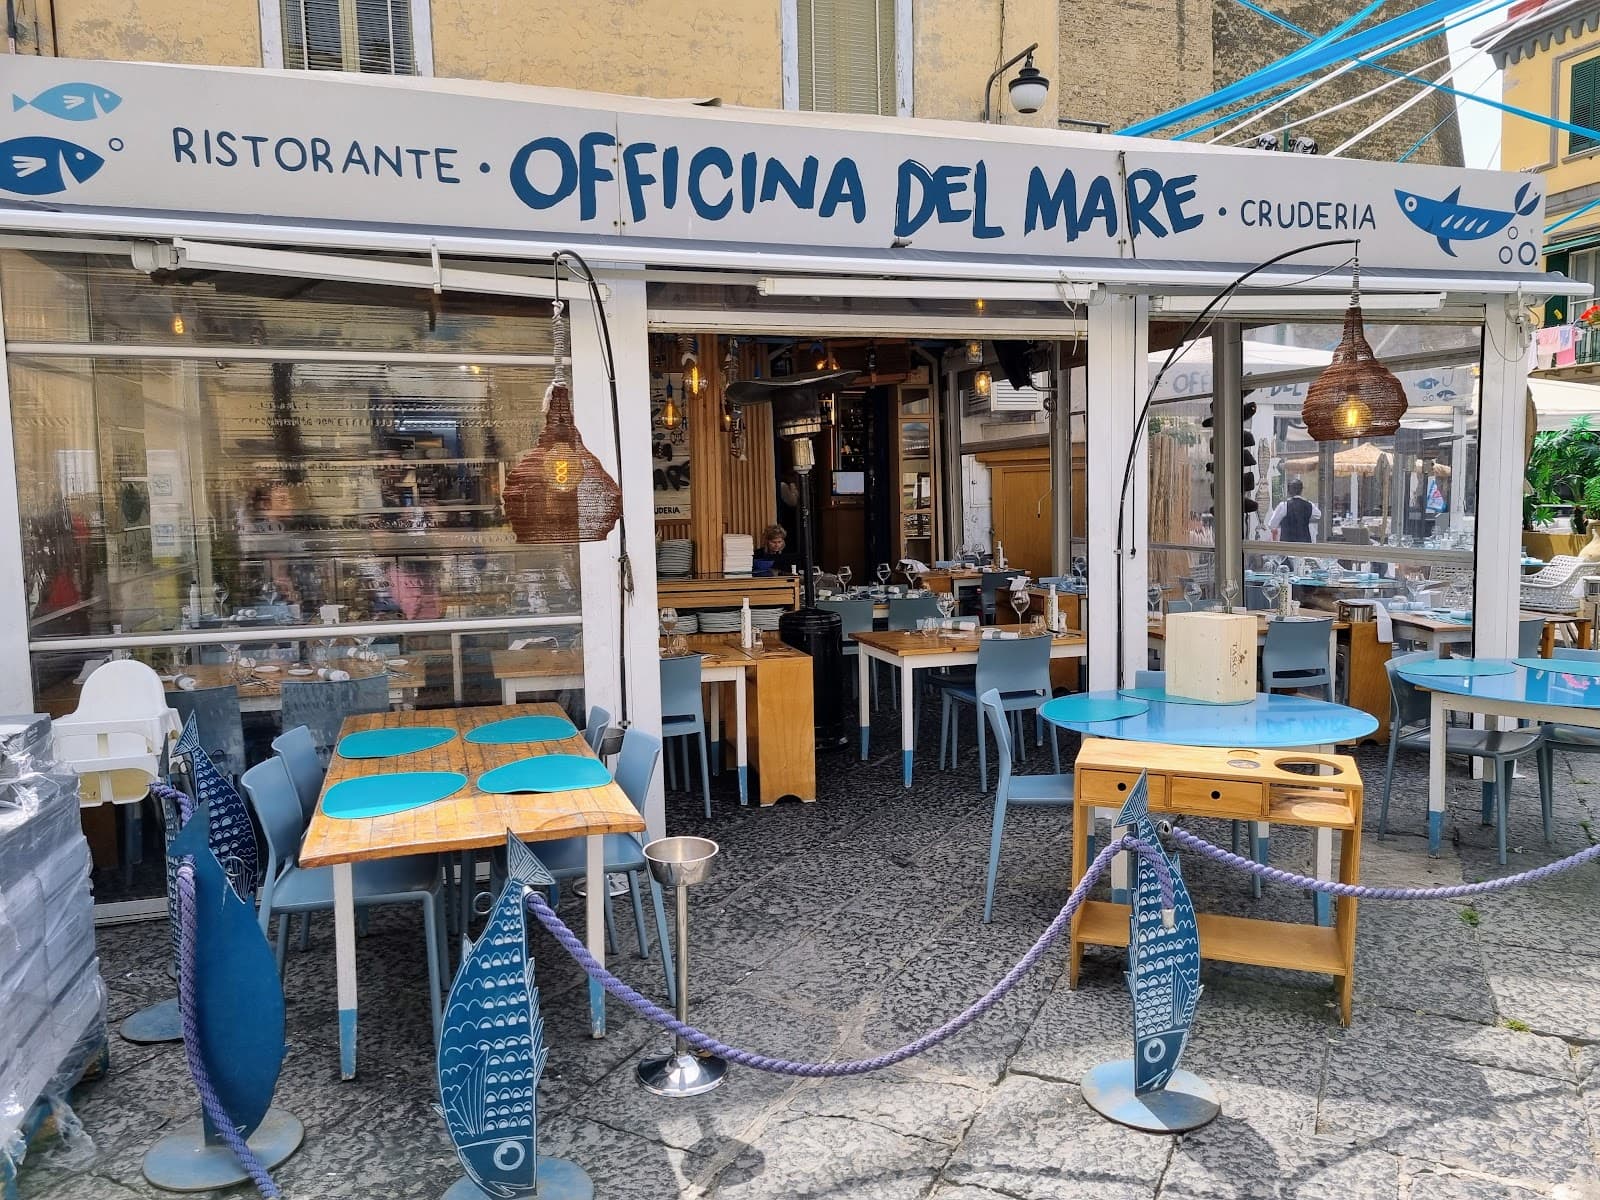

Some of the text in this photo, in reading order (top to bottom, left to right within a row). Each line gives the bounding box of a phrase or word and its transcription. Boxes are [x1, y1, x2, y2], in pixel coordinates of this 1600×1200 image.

[172, 127, 1376, 242] RISTORANTE OFFICINA DEL MARE CRUDERIA
[654, 506, 680, 514] UDERIA
